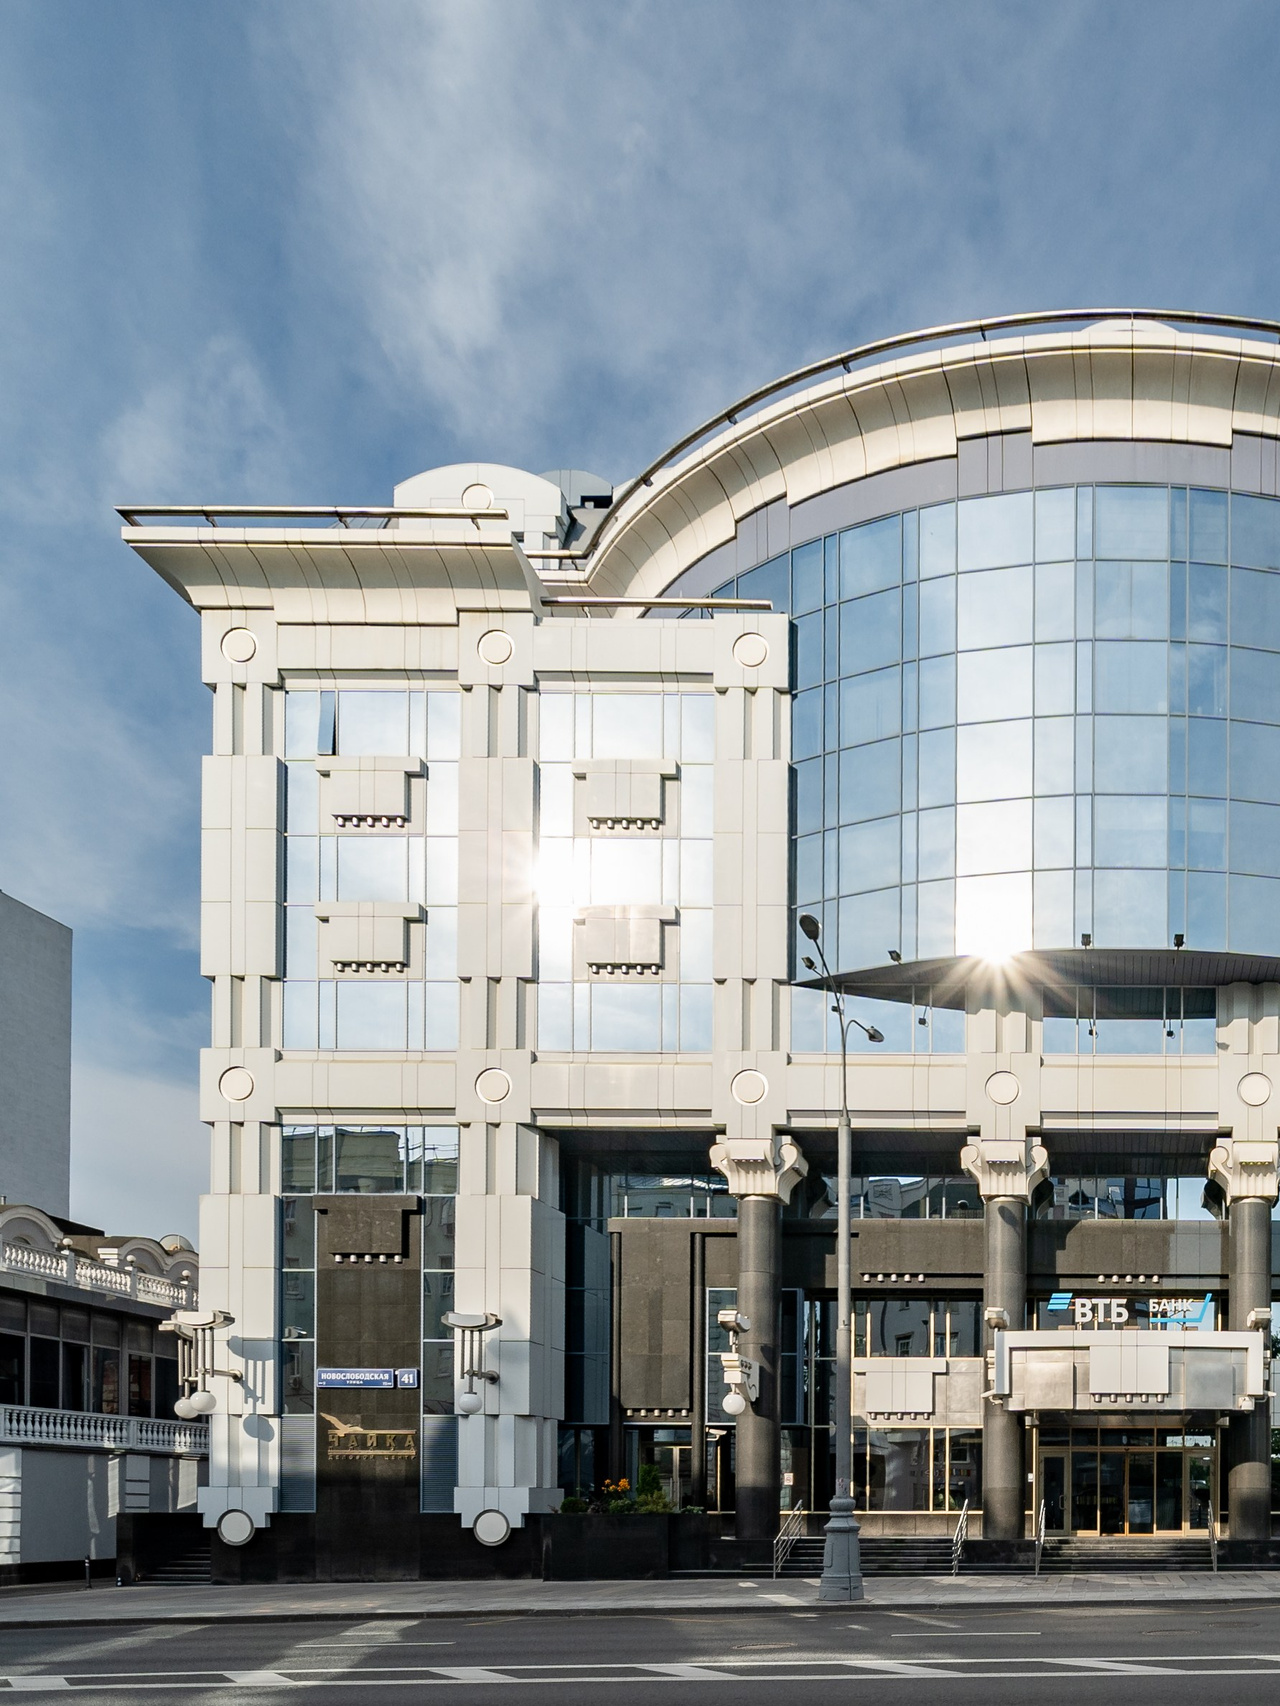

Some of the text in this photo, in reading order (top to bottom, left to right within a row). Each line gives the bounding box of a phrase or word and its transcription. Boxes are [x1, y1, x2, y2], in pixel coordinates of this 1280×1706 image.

[1074, 1298, 1194, 1323] ВТБ БАНК
[321, 1373, 389, 1381] НОВОСЛОБОДСКАЯ
[400, 1373, 414, 1384] 41
[328, 1433, 415, 1447] ЧАЙКА
